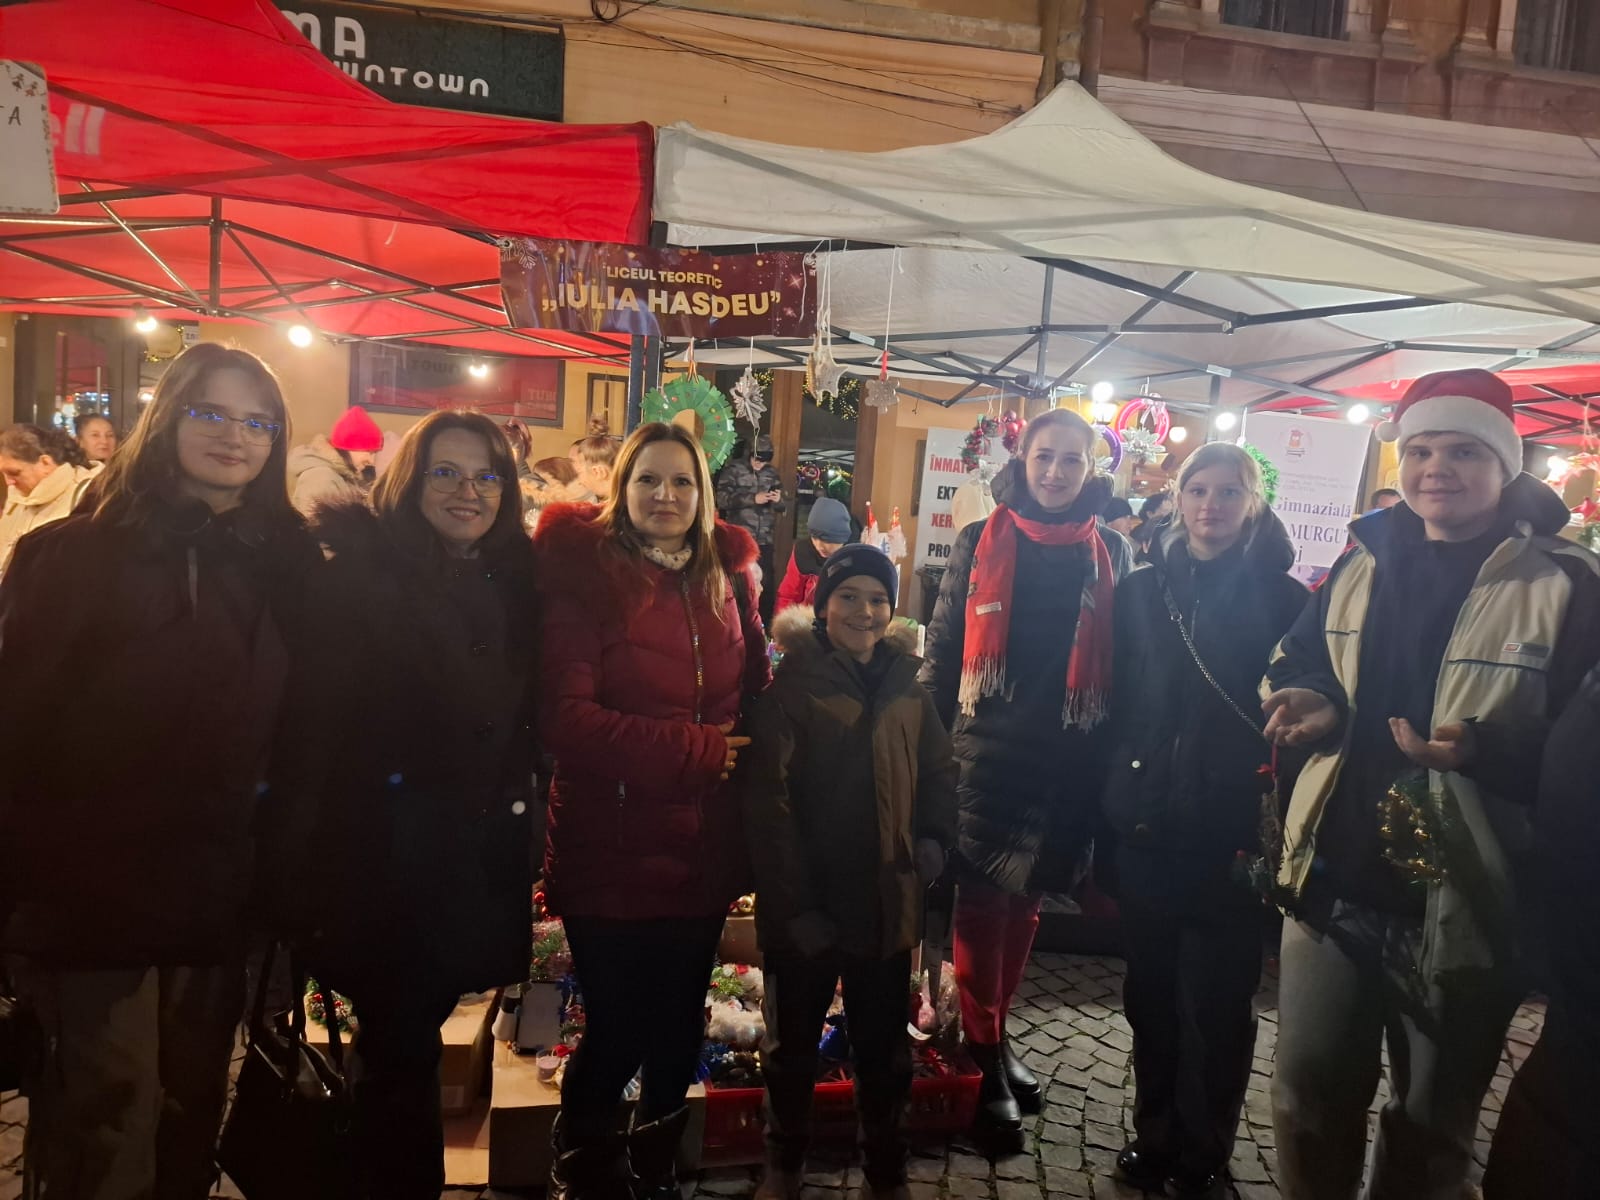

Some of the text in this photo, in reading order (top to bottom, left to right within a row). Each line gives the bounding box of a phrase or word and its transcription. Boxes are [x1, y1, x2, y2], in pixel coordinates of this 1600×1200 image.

[606, 266, 723, 289] LICEUL TEORETIC
[931, 513, 955, 528] XER
